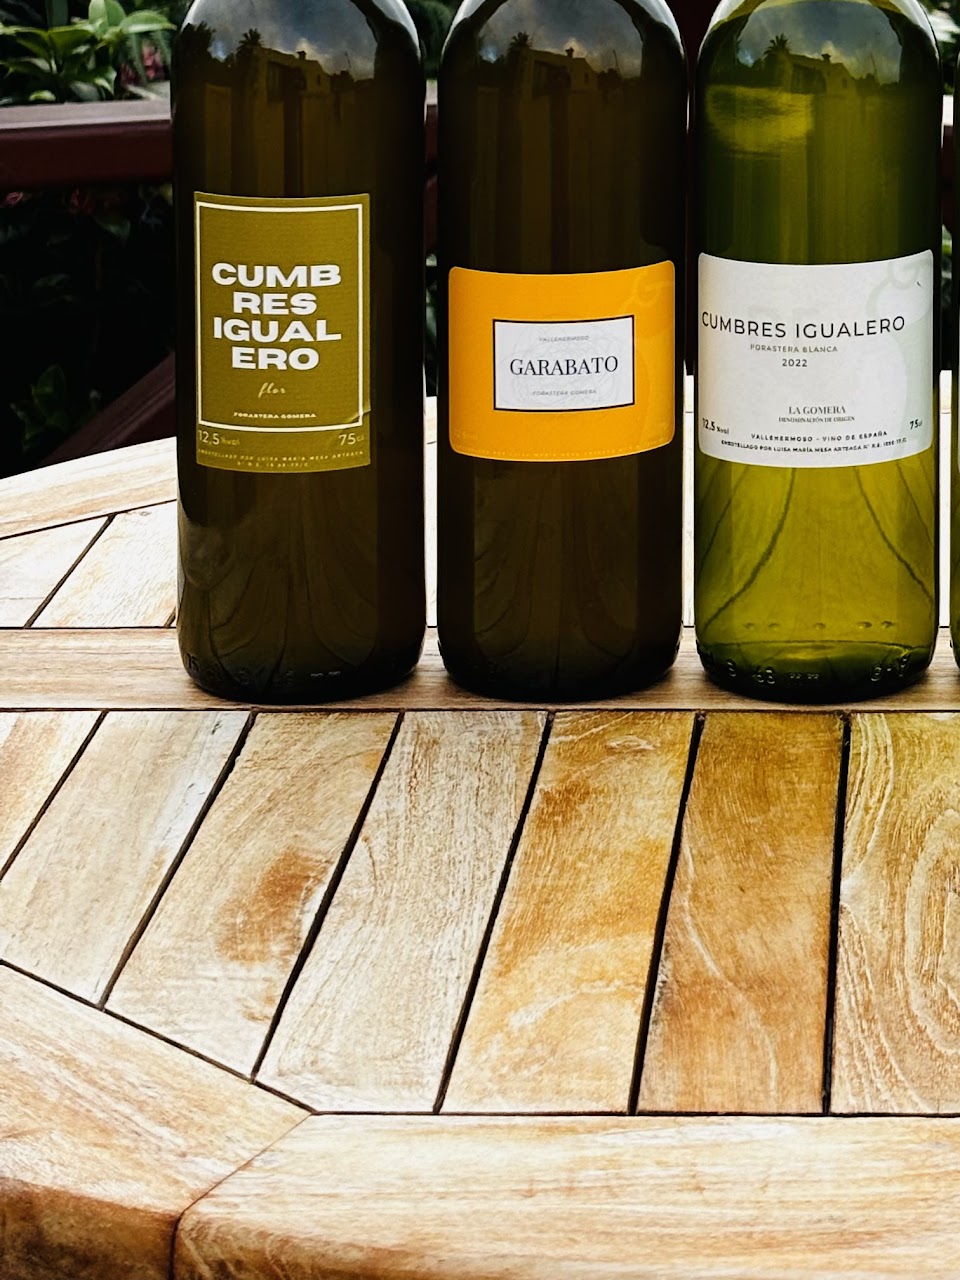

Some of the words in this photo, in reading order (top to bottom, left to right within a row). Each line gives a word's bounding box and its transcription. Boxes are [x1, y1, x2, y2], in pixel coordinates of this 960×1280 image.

[211, 262, 342, 288] CUMB
[233, 291, 317, 315] RES
[213, 317, 342, 343] IGUAL
[702, 311, 786, 338] CUMBRES
[795, 316, 905, 338] IGUALERO
[231, 346, 320, 371] ERO
[750, 343, 799, 353] FORASTERA
[802, 345, 838, 353] BLANCA
[510, 355, 618, 376] GARABATO
[782, 358, 807, 368] 2022
[234, 411, 279, 419] FORASTERA
[788, 406, 800, 415] LA
[803, 406, 846, 415] GOMERA
[751, 434, 813, 442] VALLEHERMOSO
[859, 430, 888, 440] ESPAÑA
